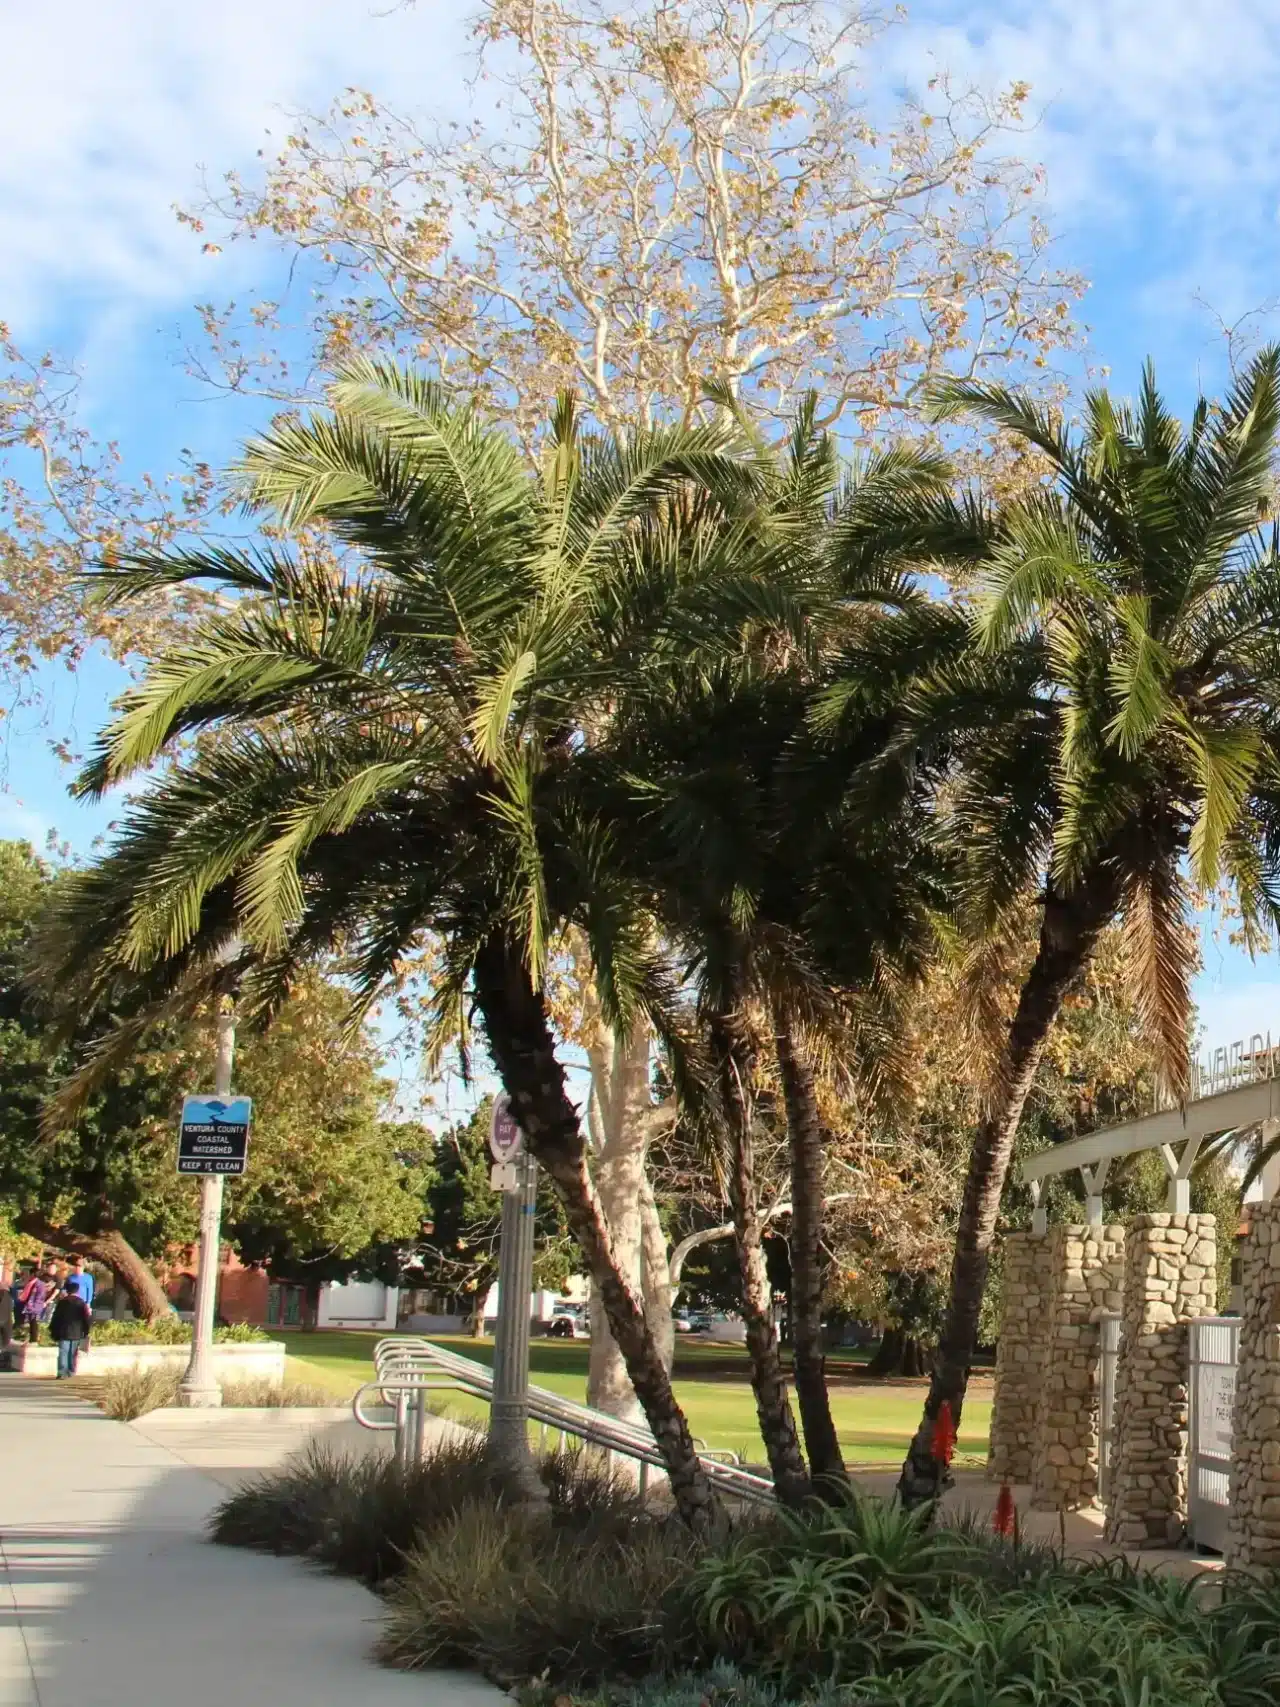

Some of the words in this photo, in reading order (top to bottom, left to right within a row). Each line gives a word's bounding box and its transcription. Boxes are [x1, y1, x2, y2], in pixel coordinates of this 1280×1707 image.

[184, 1125, 215, 1133] VENTURA
[217, 1126, 245, 1134] COUNTY
[197, 1135, 230, 1144] COASTAL
[192, 1146, 233, 1154] WATERSHED
[182, 1161, 201, 1170] KEEP
[216, 1162, 240, 1170] CLEAN
